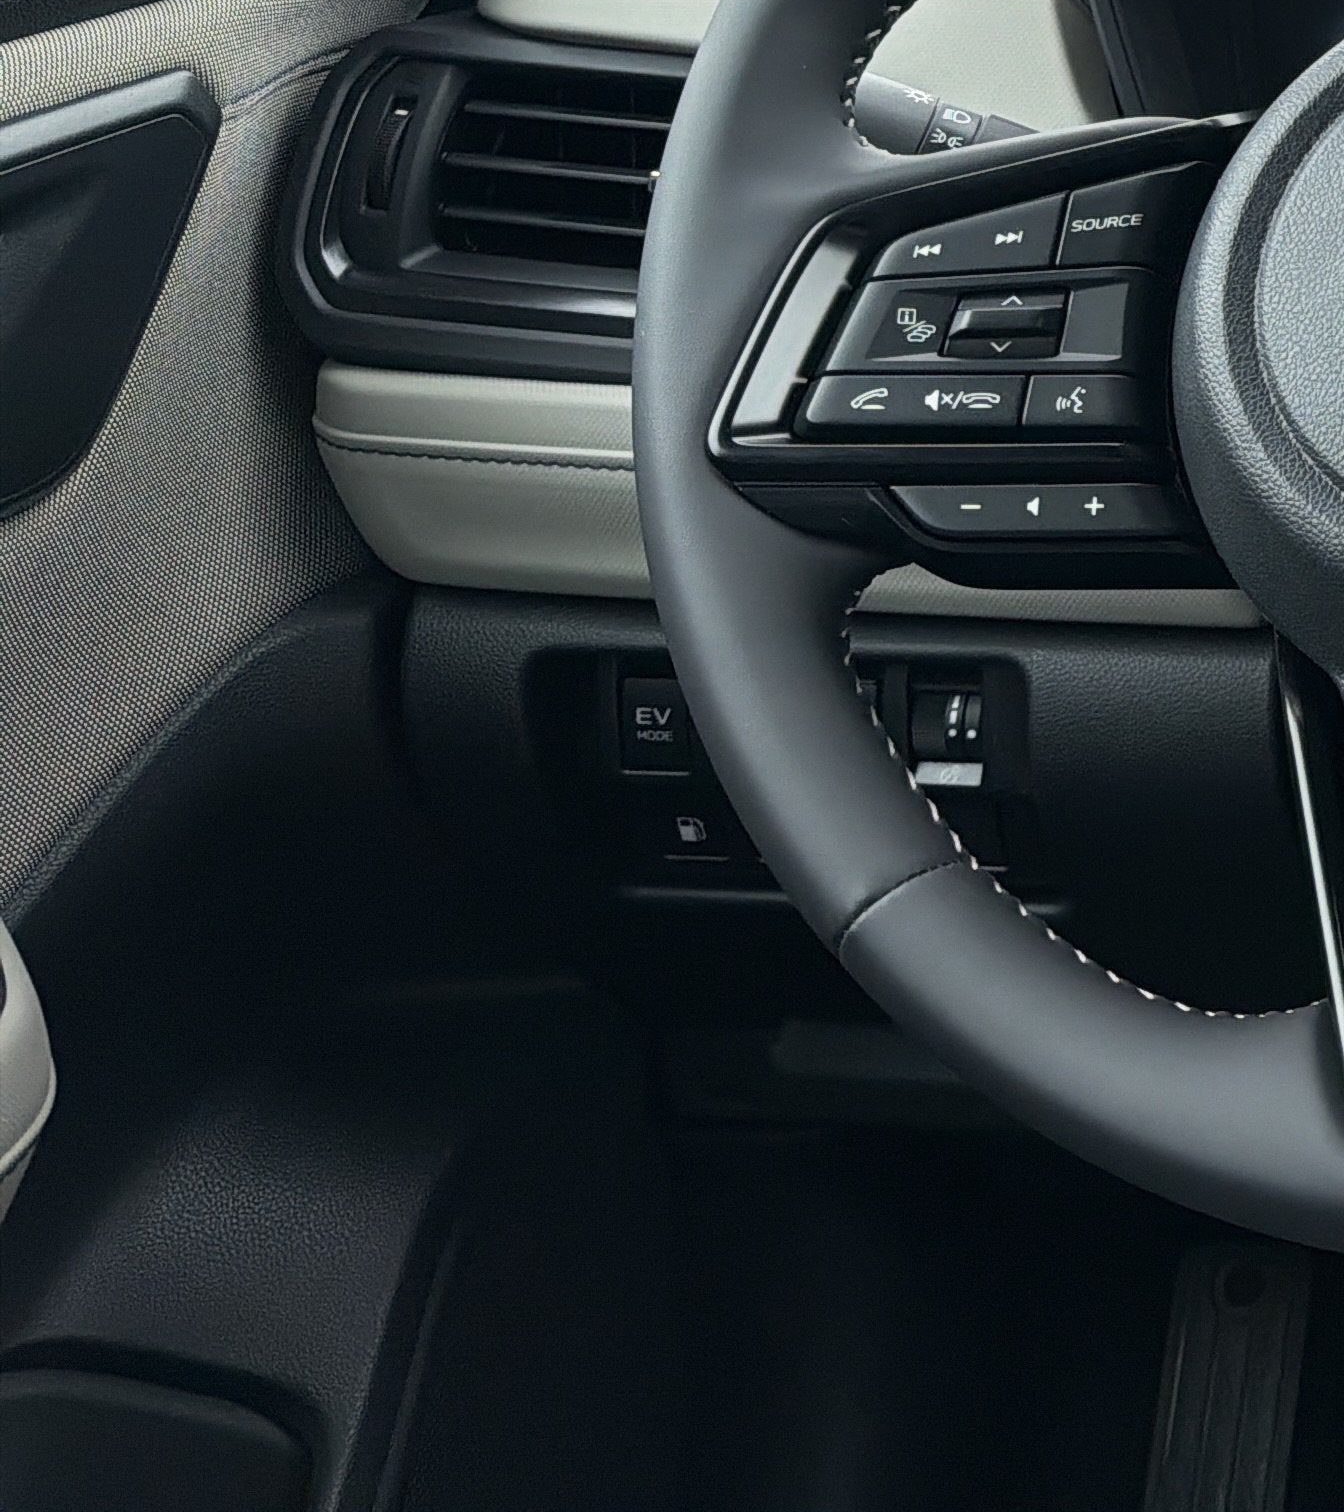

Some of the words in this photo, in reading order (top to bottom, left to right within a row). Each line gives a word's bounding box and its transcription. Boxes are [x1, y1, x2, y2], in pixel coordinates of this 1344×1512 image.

[1070, 213, 1144, 232] SOURCE
[635, 706, 672, 726] EV
[637, 729, 674, 743] MODE
